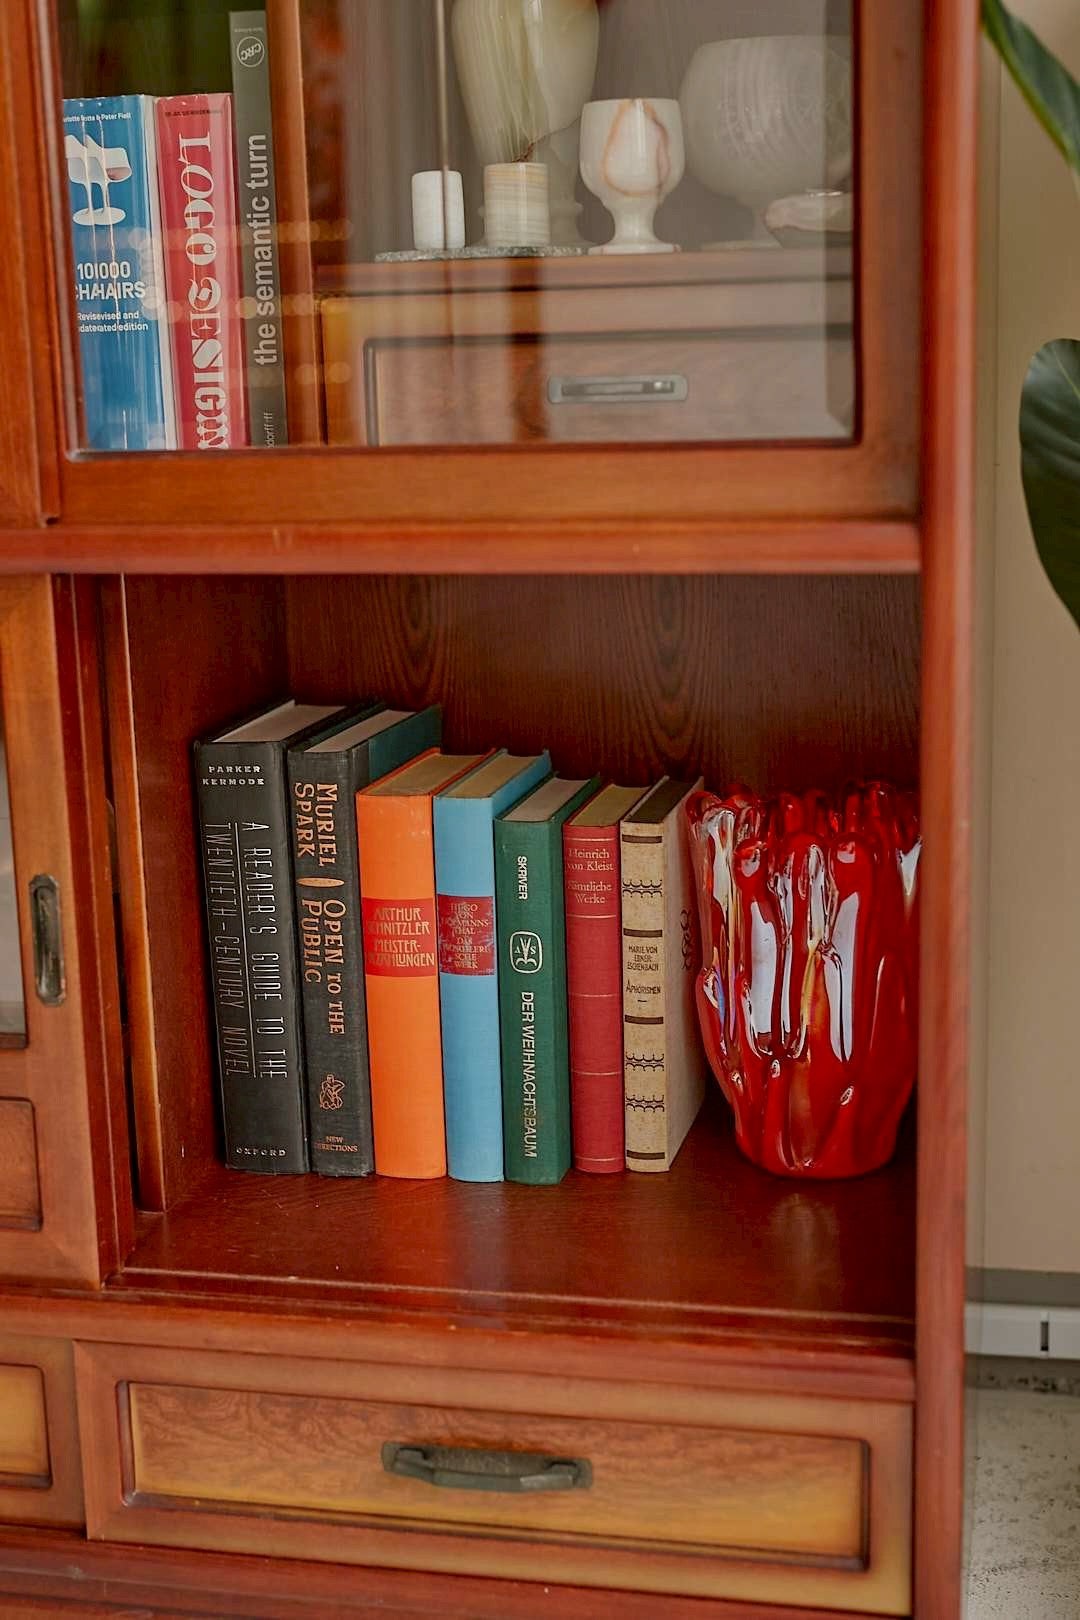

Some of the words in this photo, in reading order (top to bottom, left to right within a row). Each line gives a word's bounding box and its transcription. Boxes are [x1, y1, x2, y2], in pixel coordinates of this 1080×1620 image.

[245, 134, 269, 189] turn
[178, 131, 217, 266] LOGO
[246, 195, 275, 317] semantic
[119, 322, 149, 331] edition
[123, 311, 139, 320] and
[254, 323, 278, 366] the
[202, 778, 265, 786] KERMODE
[208, 765, 261, 774] PARKER
[241, 822, 270, 831] A
[294, 782, 315, 859] SPARK
[315, 783, 338, 867] MURIEL
[569, 848, 610, 859] Heinrich
[587, 861, 614, 871] Kleist
[243, 848, 278, 934] READER'S
[517, 855, 529, 900] SKRIVER
[375, 907, 422, 921] ARTHUR
[575, 894, 606, 904] Werke
[301, 900, 323, 983] PUBLIC
[323, 899, 346, 964] OPEN
[251, 953, 282, 1001] GUIDE
[327, 973, 342, 994] TO
[328, 1002, 345, 1035] THE
[521, 991, 535, 1023] DER
[255, 1016, 285, 1035] TO
[222, 1026, 251, 1076] NOVEL
[258, 1049, 288, 1079] THE
[522, 1025, 537, 1158] WEIHNACHTSBAUM
[236, 1147, 286, 1157] OXFORD
[325, 1135, 344, 1143] NEW
